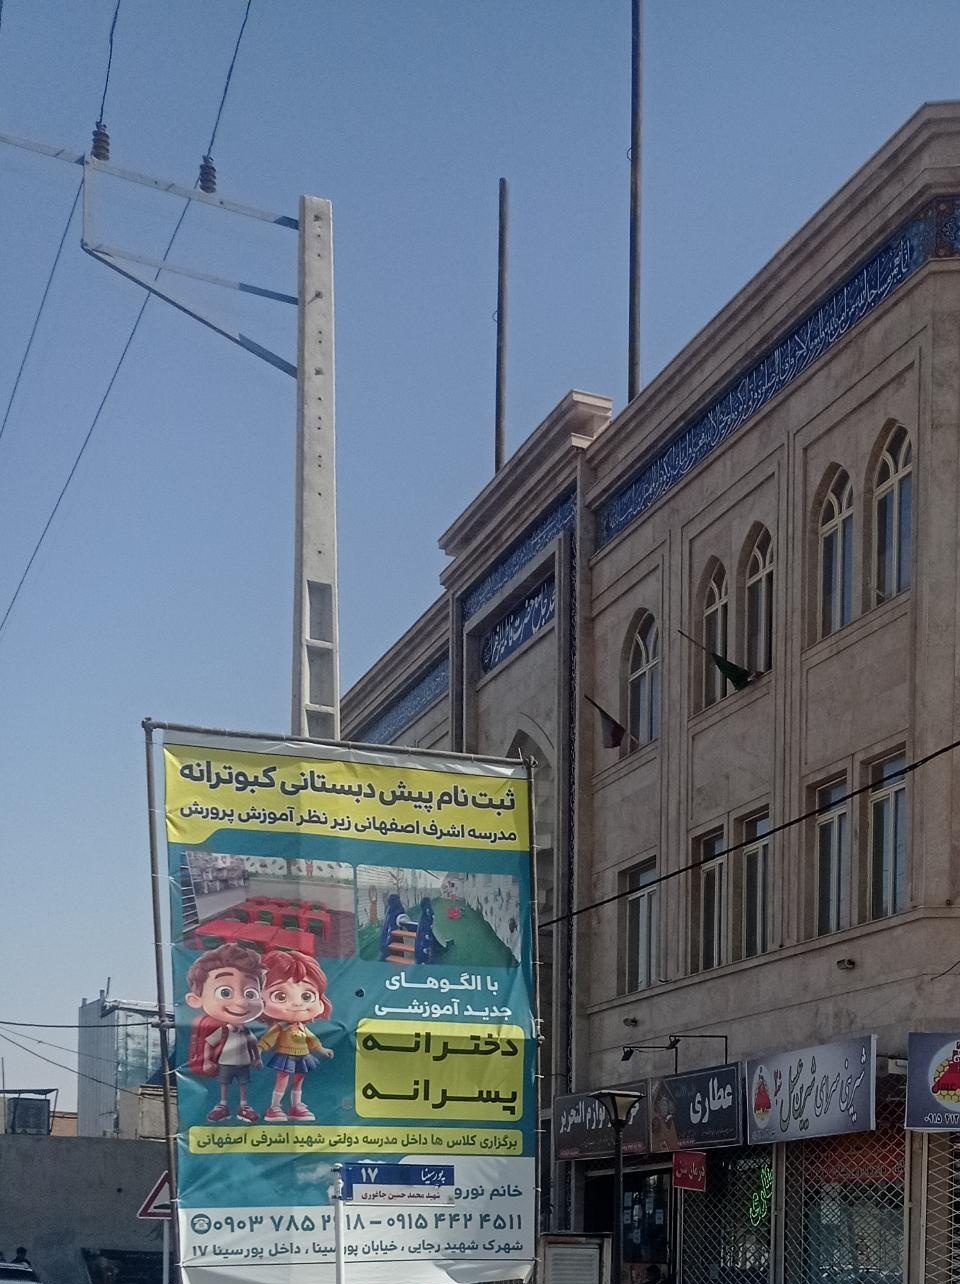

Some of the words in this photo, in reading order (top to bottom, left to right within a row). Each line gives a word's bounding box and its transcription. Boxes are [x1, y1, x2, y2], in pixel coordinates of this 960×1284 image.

[180, 761, 277, 794] کبوترانه
[280, 770, 376, 803] دبستانی
[379, 781, 433, 812] پیش
[437, 785, 469, 810] نام
[472, 788, 516, 816] ثبت
[180, 801, 234, 823] پرورش
[238, 806, 294, 824] آموزش
[296, 809, 327, 825] نظر
[330, 815, 351, 830] زیر
[355, 816, 419, 835] اصفهانی
[423, 820, 464, 840] اشرف
[468, 828, 517, 843] مدرسه
[386, 972, 481, 992] الگوهای
[486, 975, 499, 995] با
[374, 999, 460, 1017] آموزشی
[464, 1005, 512, 1020] جدید
[362, 1032, 518, 1062] دخترانه
[362, 1079, 517, 1115] پسرانه
[689, 1077, 733, 1125] عطاری
[780, 1058, 804, 1132] عسل
[814, 1072, 841, 1118] سرای
[924, 1113, 943, 1124] ۰۹۱۵
[197, 1133, 247, 1149] اصفهانی
[251, 1131, 289, 1147] اشرفی
[293, 1133, 325, 1148] شهید
[328, 1133, 359, 1147] دولتی
[362, 1135, 397, 1146] مدرسه
[401, 1133, 427, 1147] داخل
[431, 1133, 443, 1146] ها
[446, 1134, 476, 1147] کلاس
[479, 1135, 517, 1150] برگزاری
[361, 1167, 379, 1183] ۱۷
[421, 1167, 446, 1184] پورسینا
[388, 1191, 406, 1201] حسین
[407, 1192, 425, 1200] محمد
[426, 1191, 441, 1200] شهید
[455, 1184, 484, 1200] نورو
[489, 1184, 523, 1200] خانم
[213, 1215, 263, 1232] ۰۹۰۳
[270, 1215, 315, 1232] ۷۸۵
[322, 1214, 366, 1231] ۲۱۸
[387, 1213, 428, 1230] ۰۹۱۵
[434, 1213, 473, 1230] ۴۴۲
[479, 1213, 522, 1230] ۴۵۱۱
[192, 1245, 208, 1257] ۱۷
[213, 1245, 263, 1259] پورسینا
[269, 1242, 300, 1256] داخل
[362, 1241, 397, 1256] خیابان
[445, 1240, 478, 1254] شهید
[483, 1240, 523, 1252] شهرک
